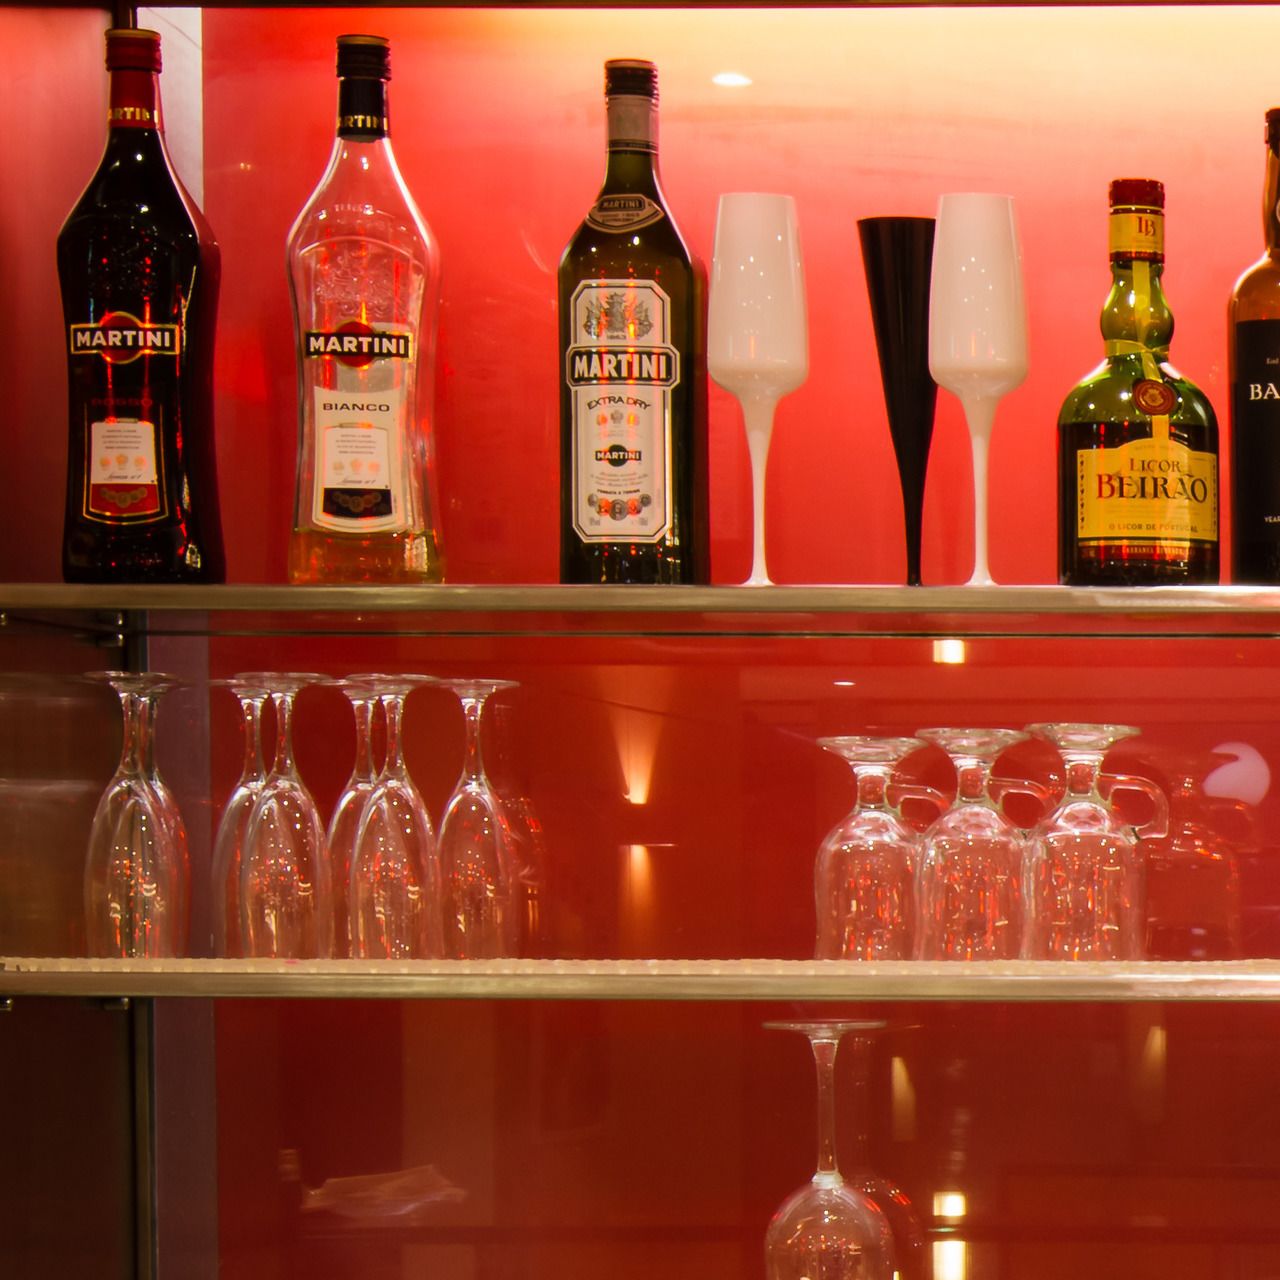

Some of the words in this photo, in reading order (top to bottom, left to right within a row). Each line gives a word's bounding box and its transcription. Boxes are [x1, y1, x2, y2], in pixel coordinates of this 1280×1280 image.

[76, 330, 170, 347] MARTINI
[309, 336, 405, 354] MARTINI
[574, 354, 667, 379] MARTINI
[322, 403, 390, 412] BIANCO
[587, 396, 625, 410] EXTRA
[626, 396, 651, 410] DRY
[596, 451, 641, 460] MARTINI
[1130, 458, 1181, 473] LICOR
[1096, 472, 1208, 504] BEIRÃO
